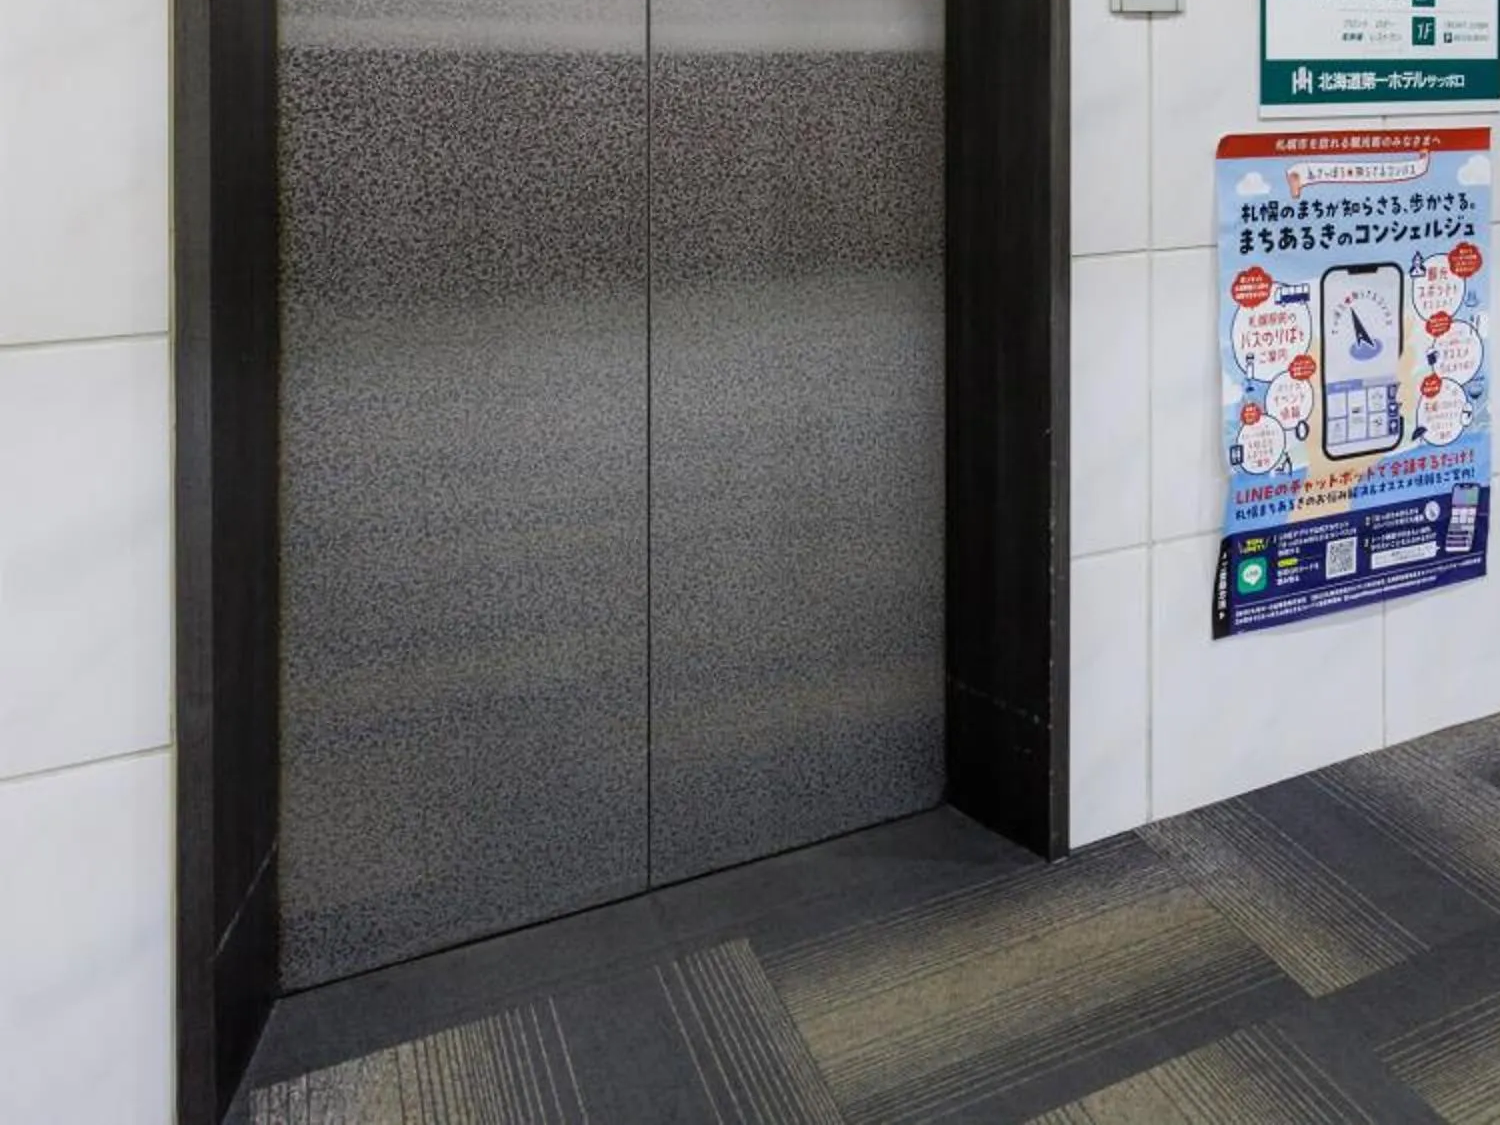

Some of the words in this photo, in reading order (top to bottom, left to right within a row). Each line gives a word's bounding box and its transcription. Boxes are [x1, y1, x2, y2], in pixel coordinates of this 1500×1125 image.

[1415, 22, 1434, 41] 1F
[1239, 216, 1476, 255] まちあるきのコンシェルジュ
